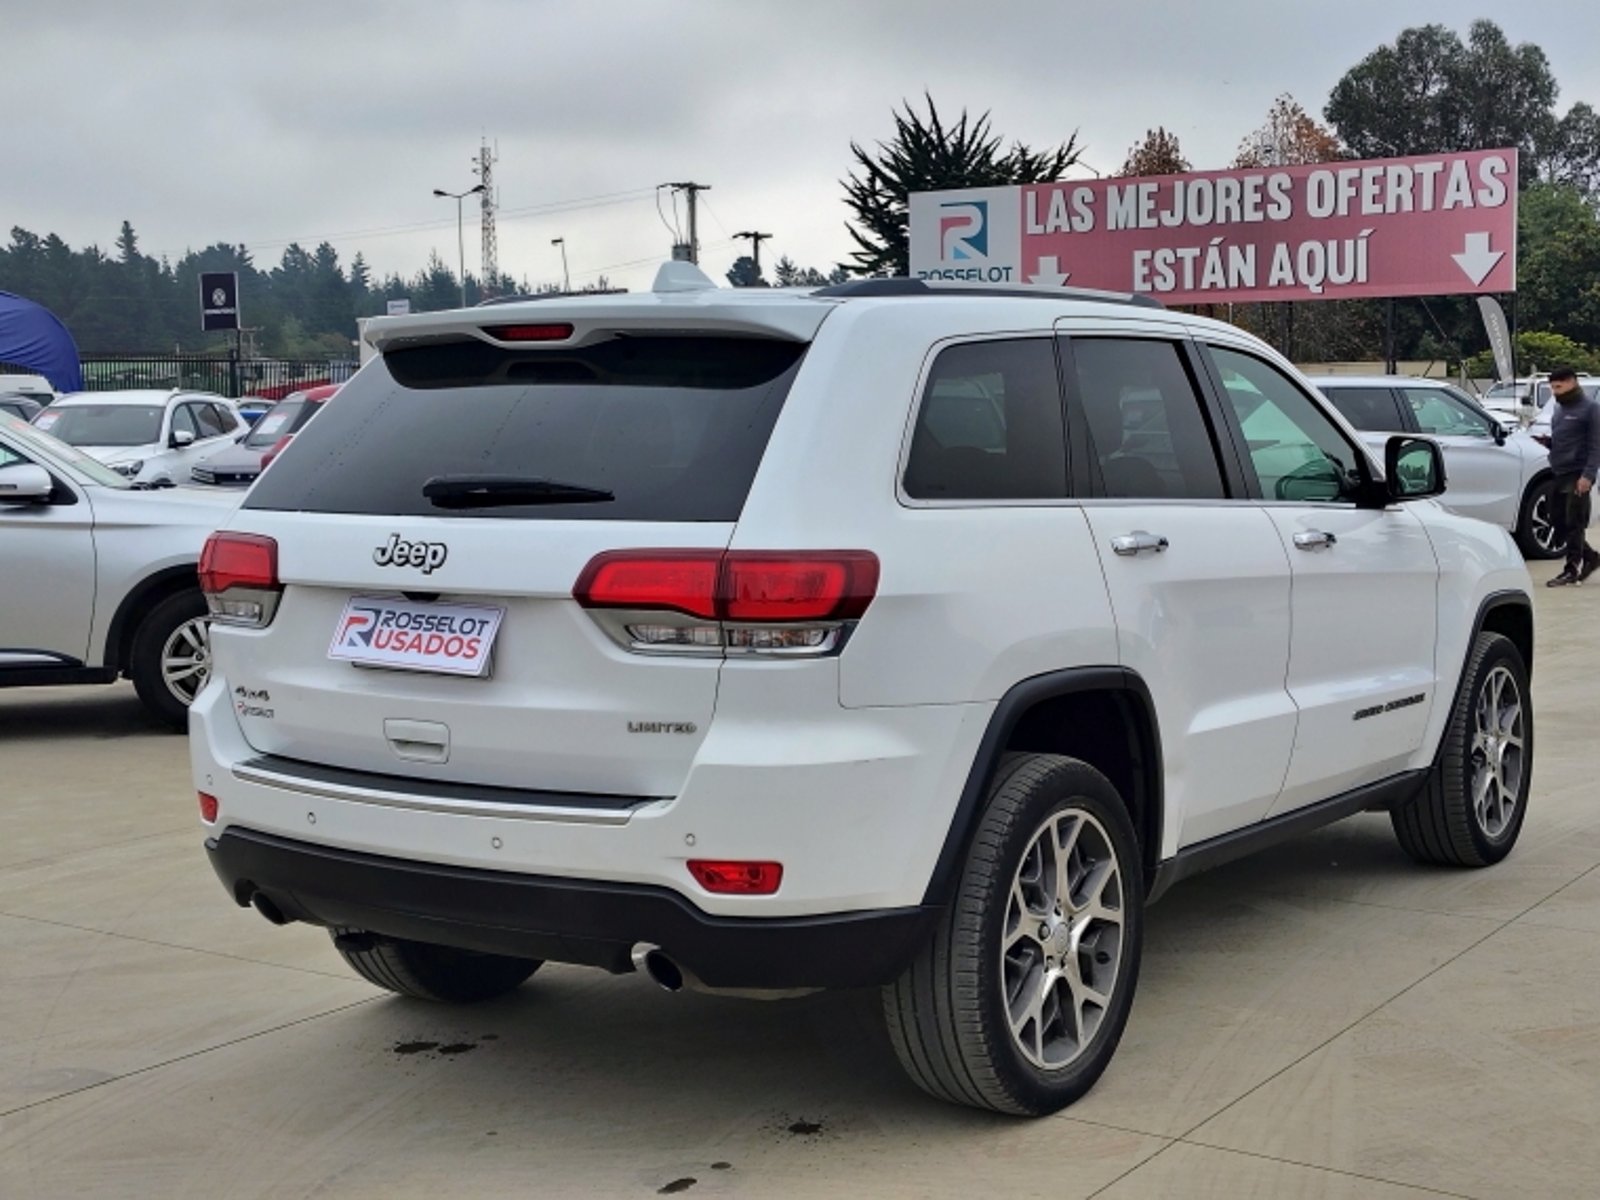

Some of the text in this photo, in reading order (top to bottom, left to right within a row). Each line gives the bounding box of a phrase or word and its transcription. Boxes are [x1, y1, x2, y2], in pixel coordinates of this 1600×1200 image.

[1027, 156, 1508, 234] LAS MEJORES OFERTAS
[1133, 228, 1376, 294] ESTÁN AQUÍ
[373, 532, 448, 575] Jeep
[373, 629, 481, 660] USADOS
[380, 610, 490, 637] ROSSELOT
